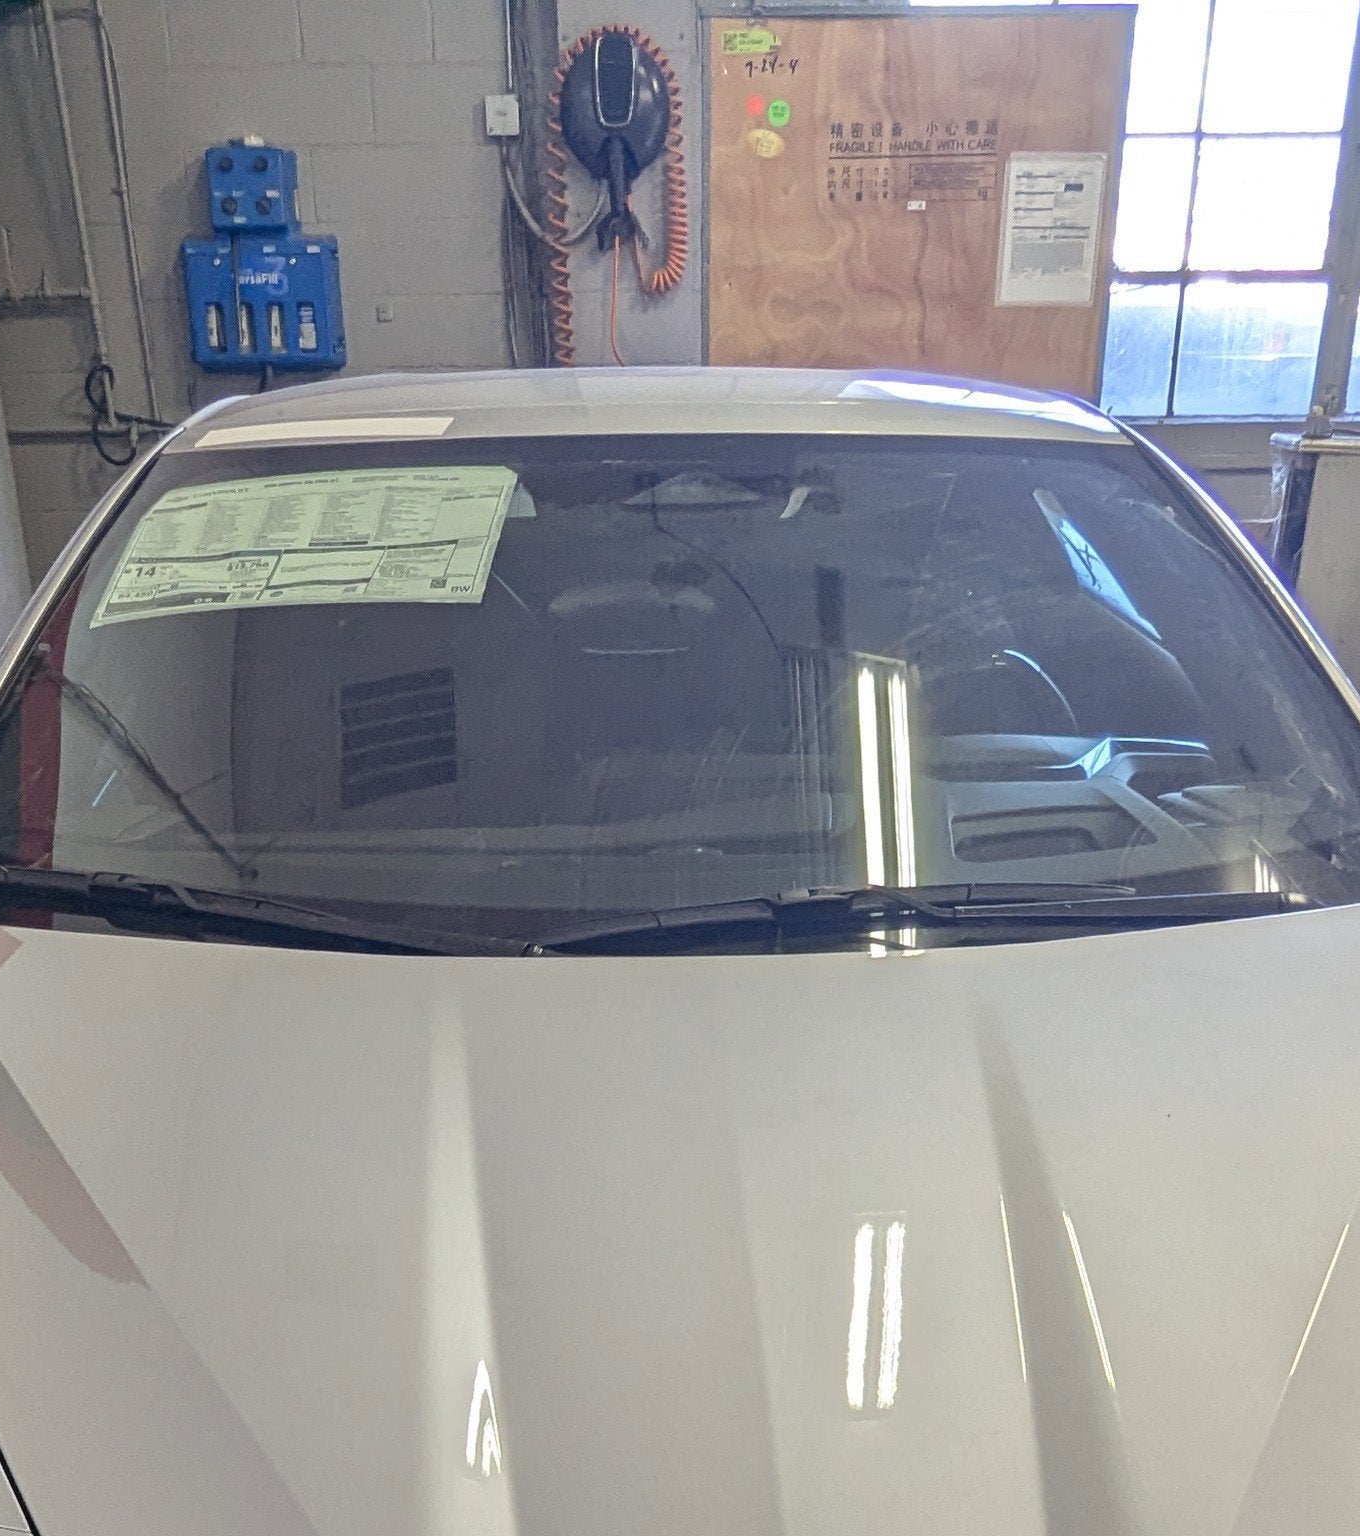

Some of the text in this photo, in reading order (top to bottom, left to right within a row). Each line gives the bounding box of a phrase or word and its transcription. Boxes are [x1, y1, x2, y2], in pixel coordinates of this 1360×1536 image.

[829, 141, 874, 153] FRAGILE
[890, 140, 931, 152] HANDLE
[938, 139, 964, 151] WITH
[968, 137, 997, 150] CARE
[134, 566, 157, 577] 14
